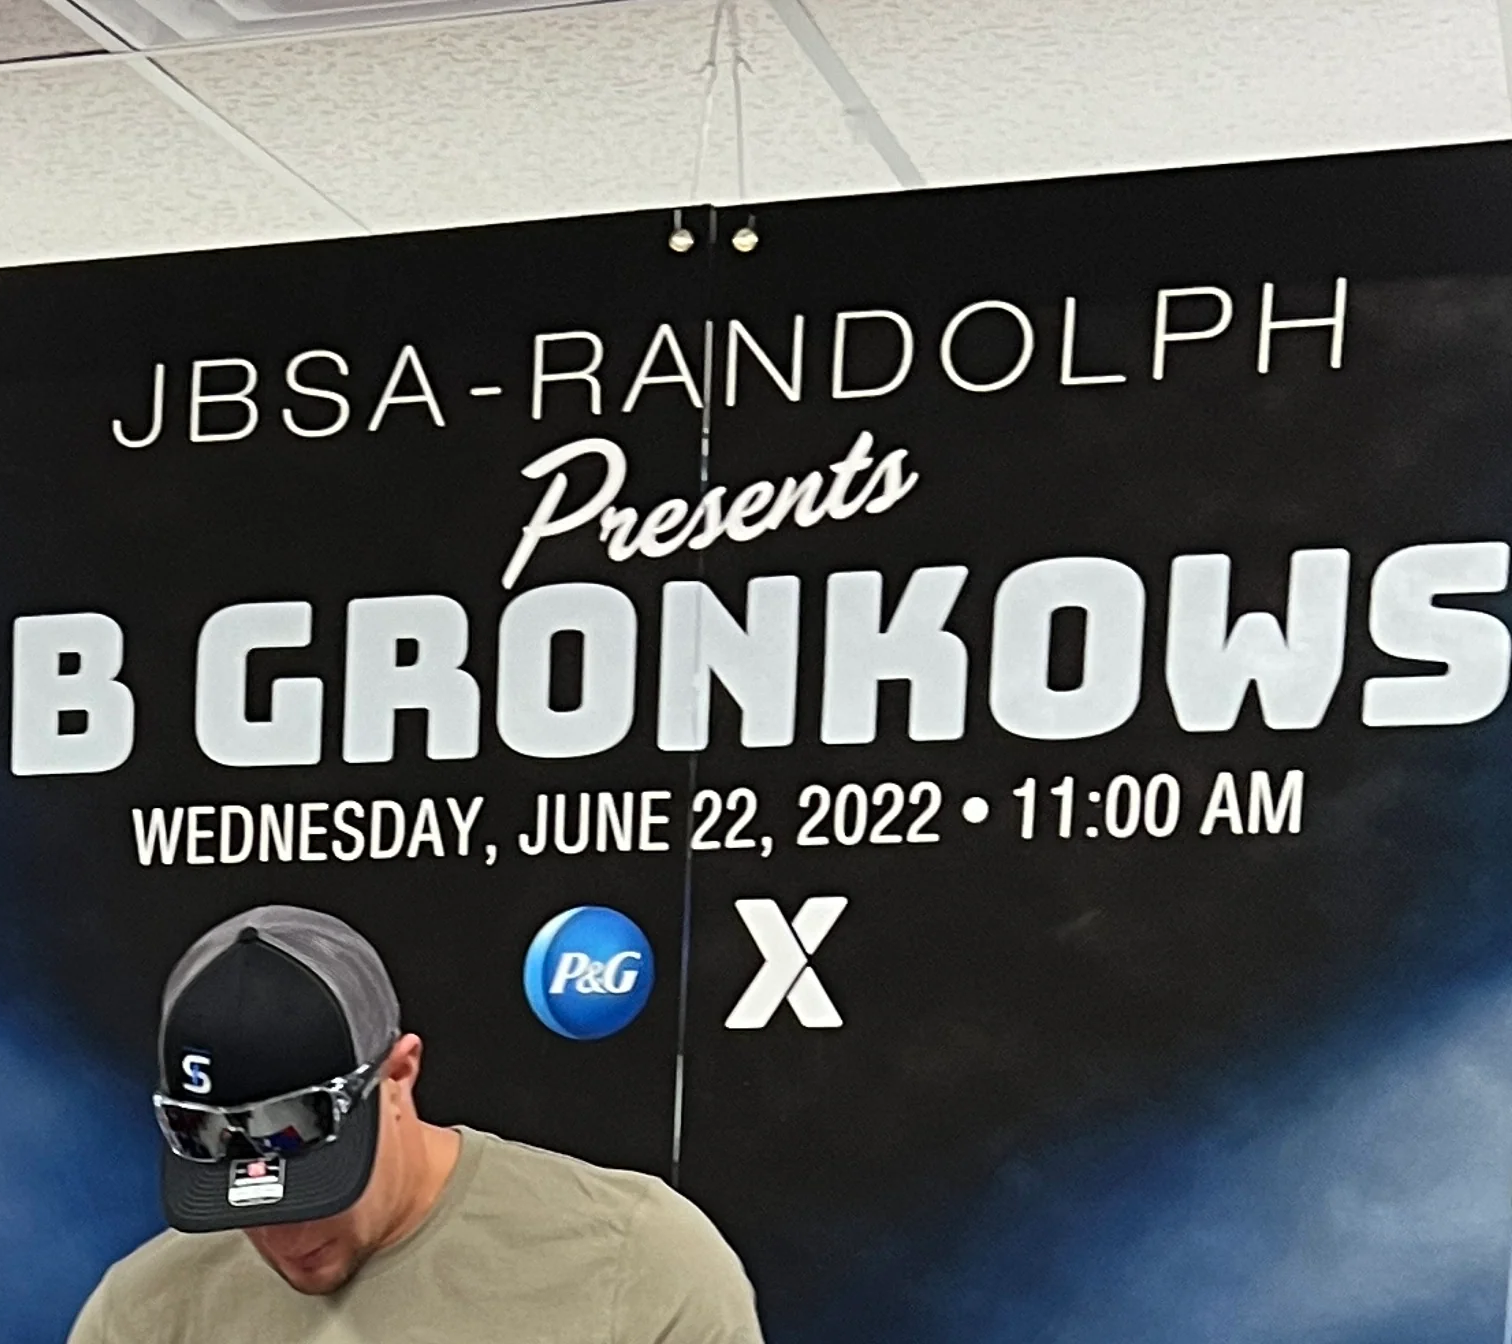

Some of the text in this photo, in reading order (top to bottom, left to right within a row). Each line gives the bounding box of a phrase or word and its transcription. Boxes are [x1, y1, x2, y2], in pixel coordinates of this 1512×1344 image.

[112, 276, 1347, 448] JBSA-RANDOLPH
[501, 430, 919, 590] Presents
[195, 541, 1512, 768] GRONKOWS
[131, 768, 1305, 867] WEDNESDAY, JUNE 22, 2022 11:00 AM
[548, 950, 642, 994] P&G
